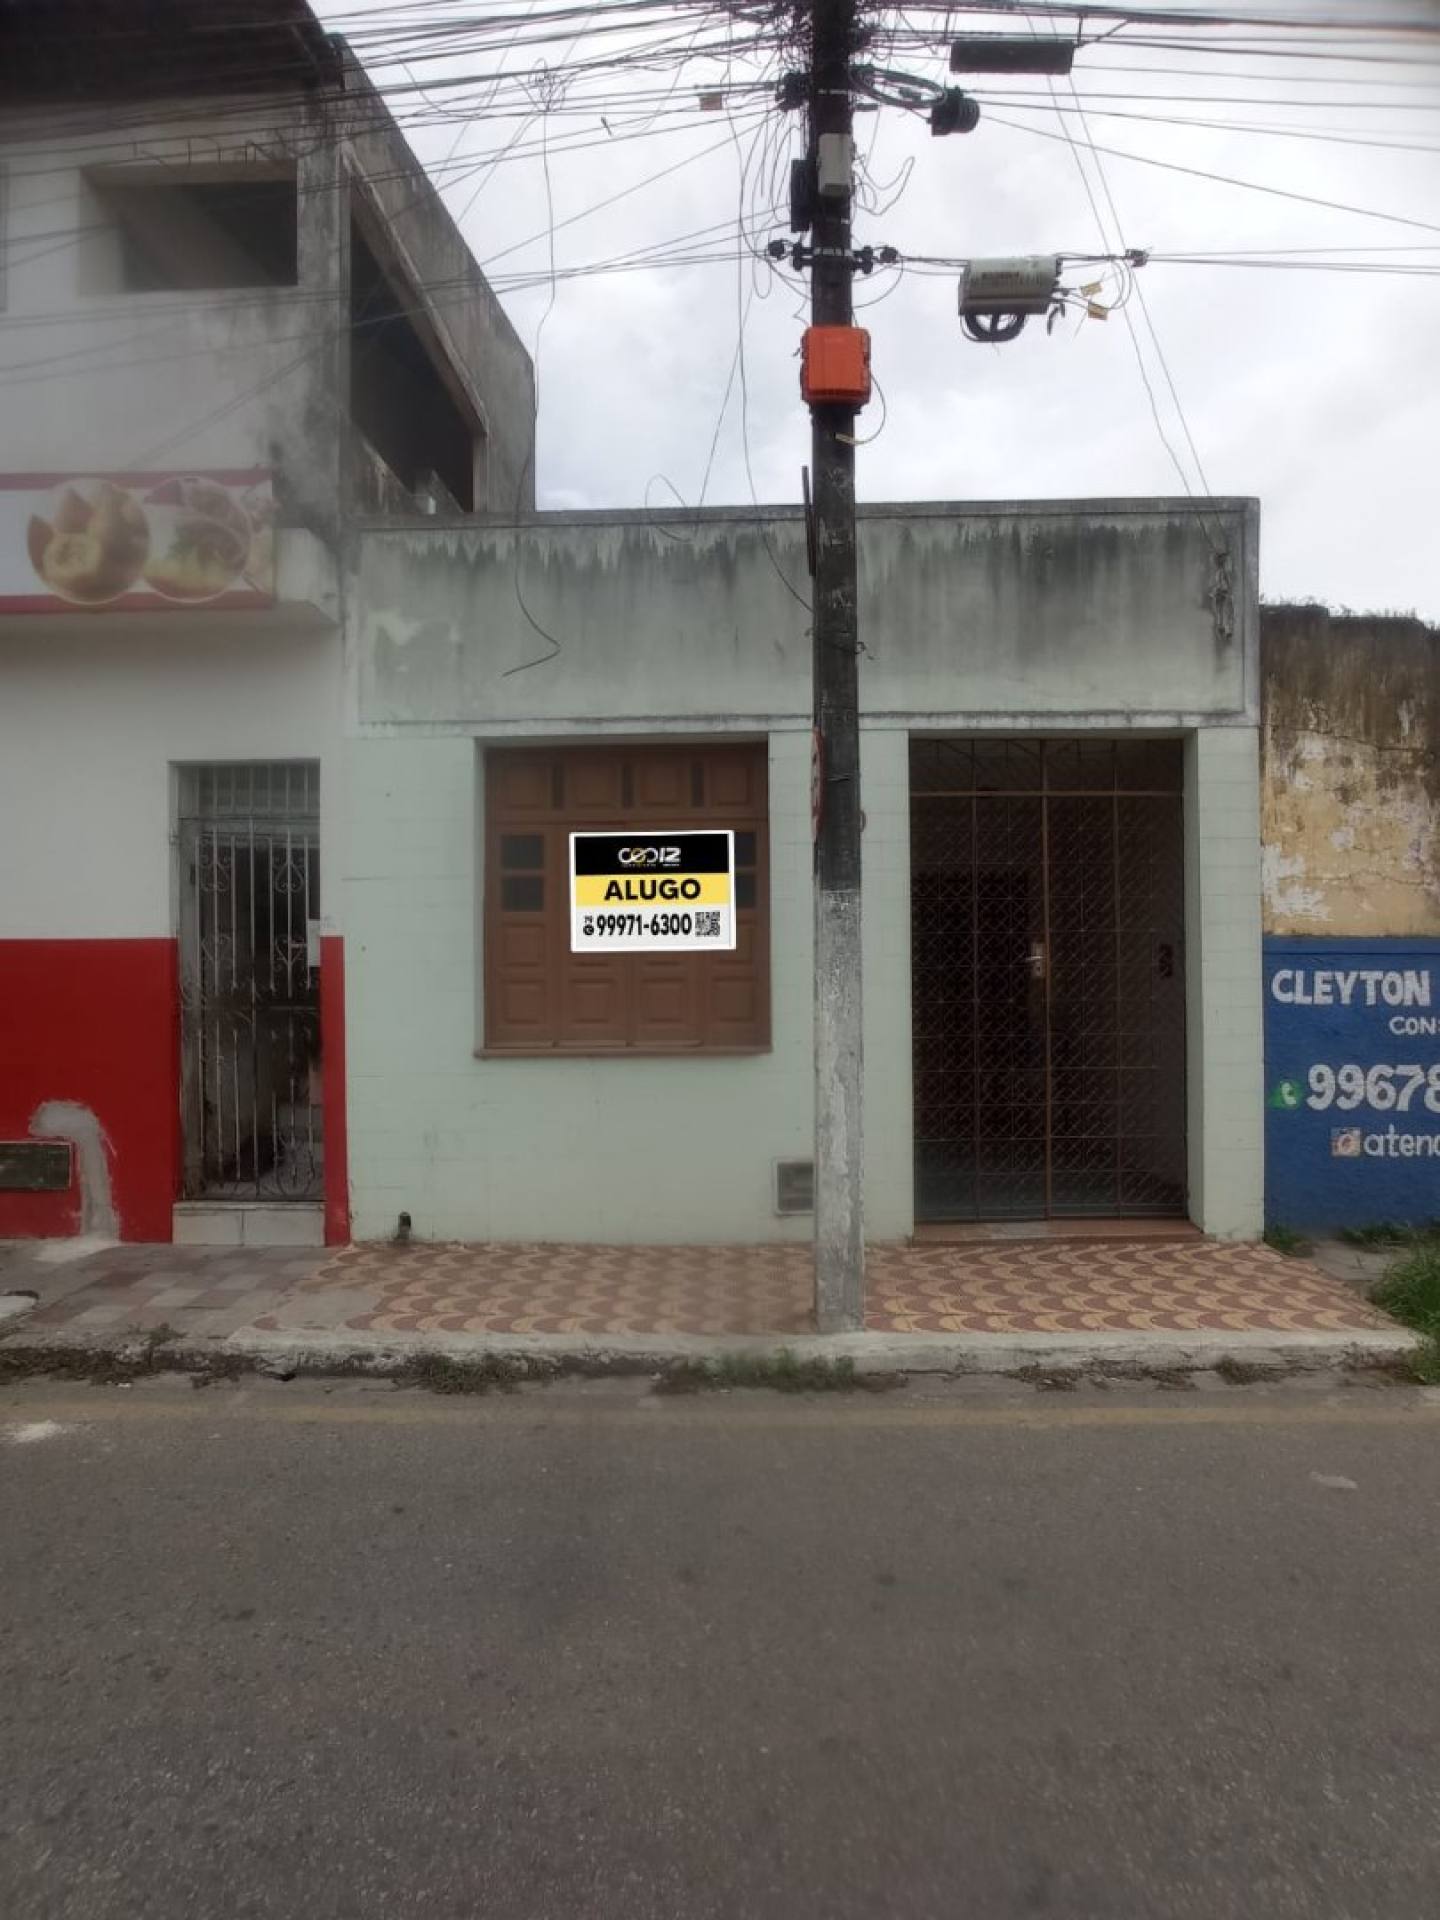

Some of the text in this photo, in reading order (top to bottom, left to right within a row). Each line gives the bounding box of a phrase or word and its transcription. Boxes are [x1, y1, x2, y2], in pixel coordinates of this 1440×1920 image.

[604, 877, 701, 901] ALUGO
[597, 913, 692, 936] 99971-6300
[1271, 969, 1432, 1006] CLEYTON
[1389, 1015, 1440, 1036] CON
[1306, 1064, 1440, 1113] 99678
